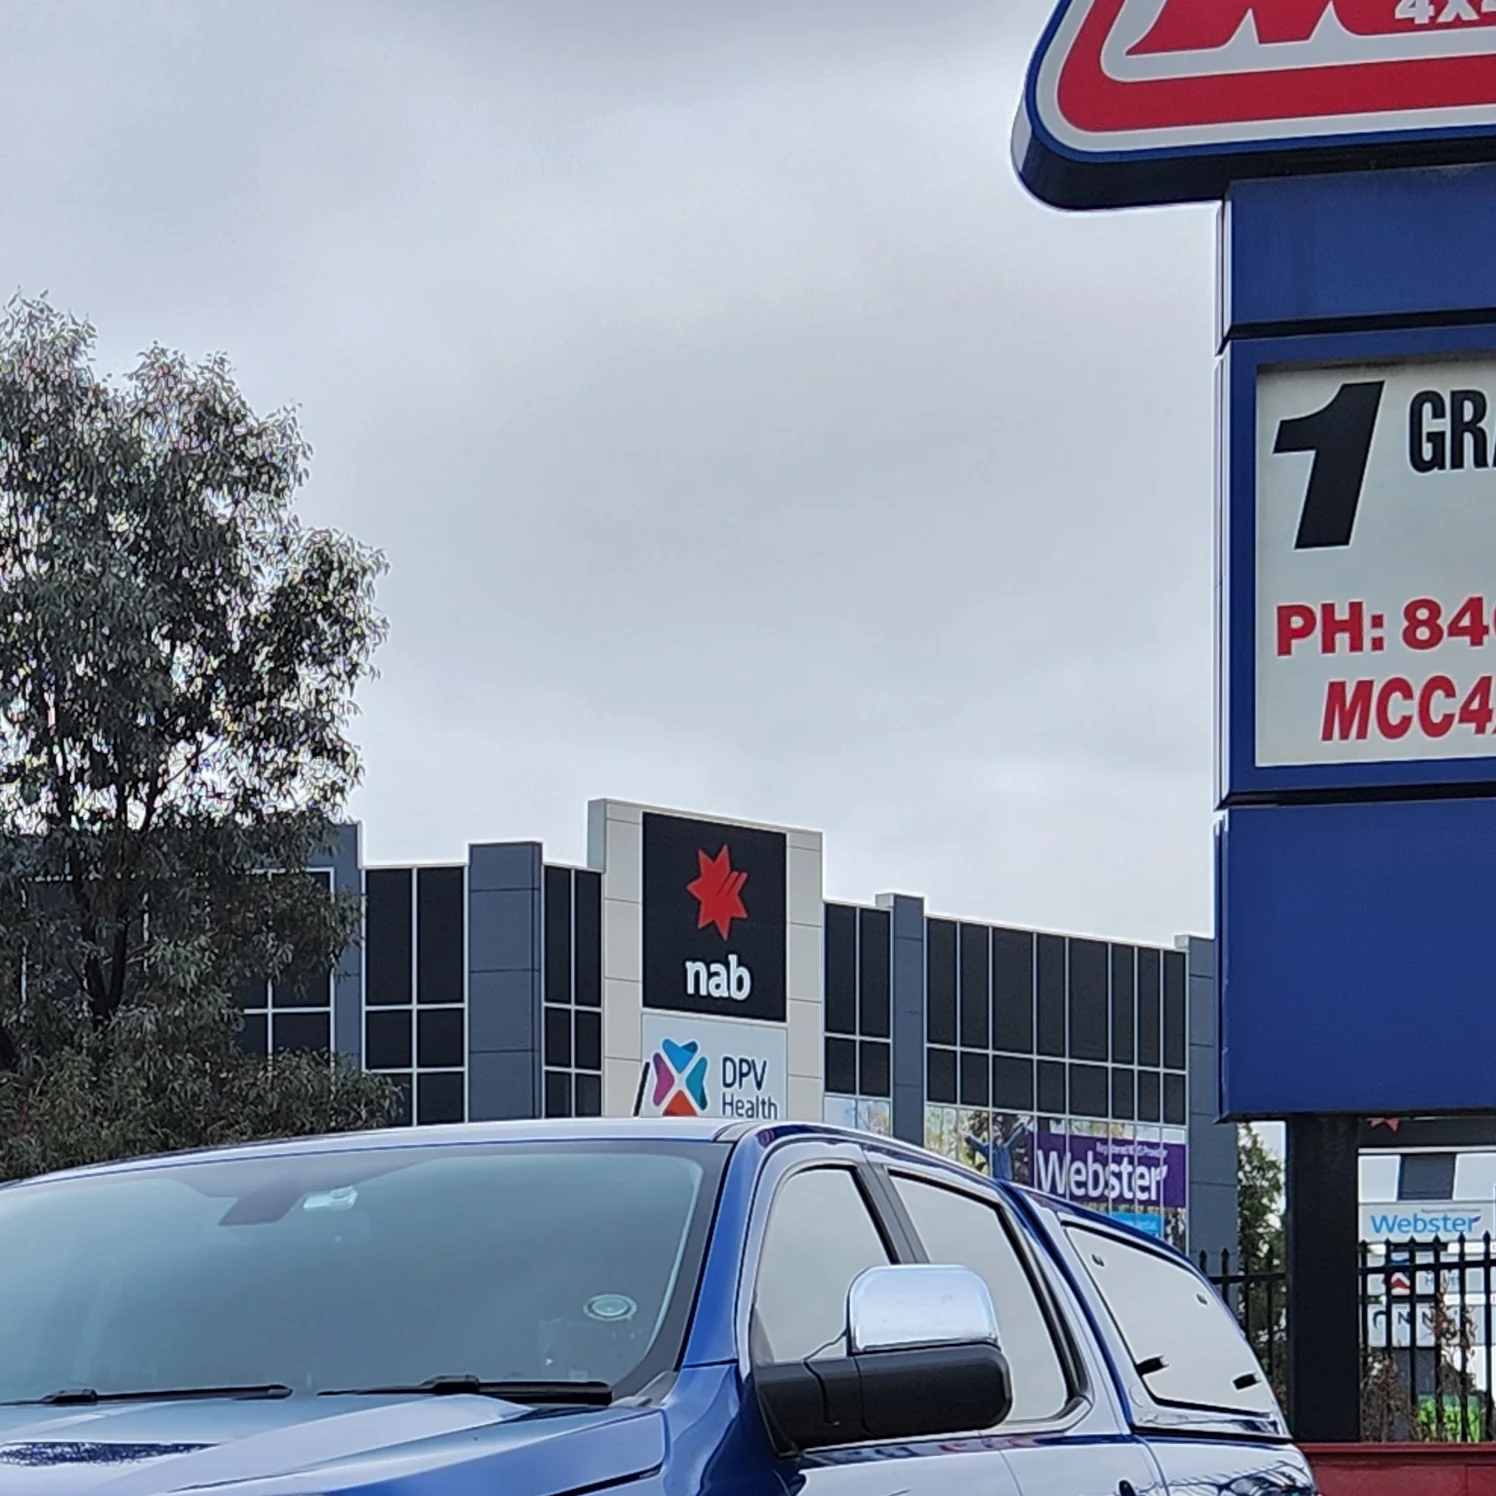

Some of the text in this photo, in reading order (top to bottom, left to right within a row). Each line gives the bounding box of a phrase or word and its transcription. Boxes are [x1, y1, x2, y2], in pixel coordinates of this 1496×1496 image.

[1273, 380, 1496, 550] 1 GR
[1275, 596, 1496, 657] PH: 84
[1320, 674, 1496, 742] MCC4
[685, 954, 752, 1001] nab
[721, 1055, 767, 1091] DPV
[721, 1092, 778, 1120] Health
[1036, 1148, 1168, 1201] Webster
[1369, 1212, 1482, 1235] Webster
